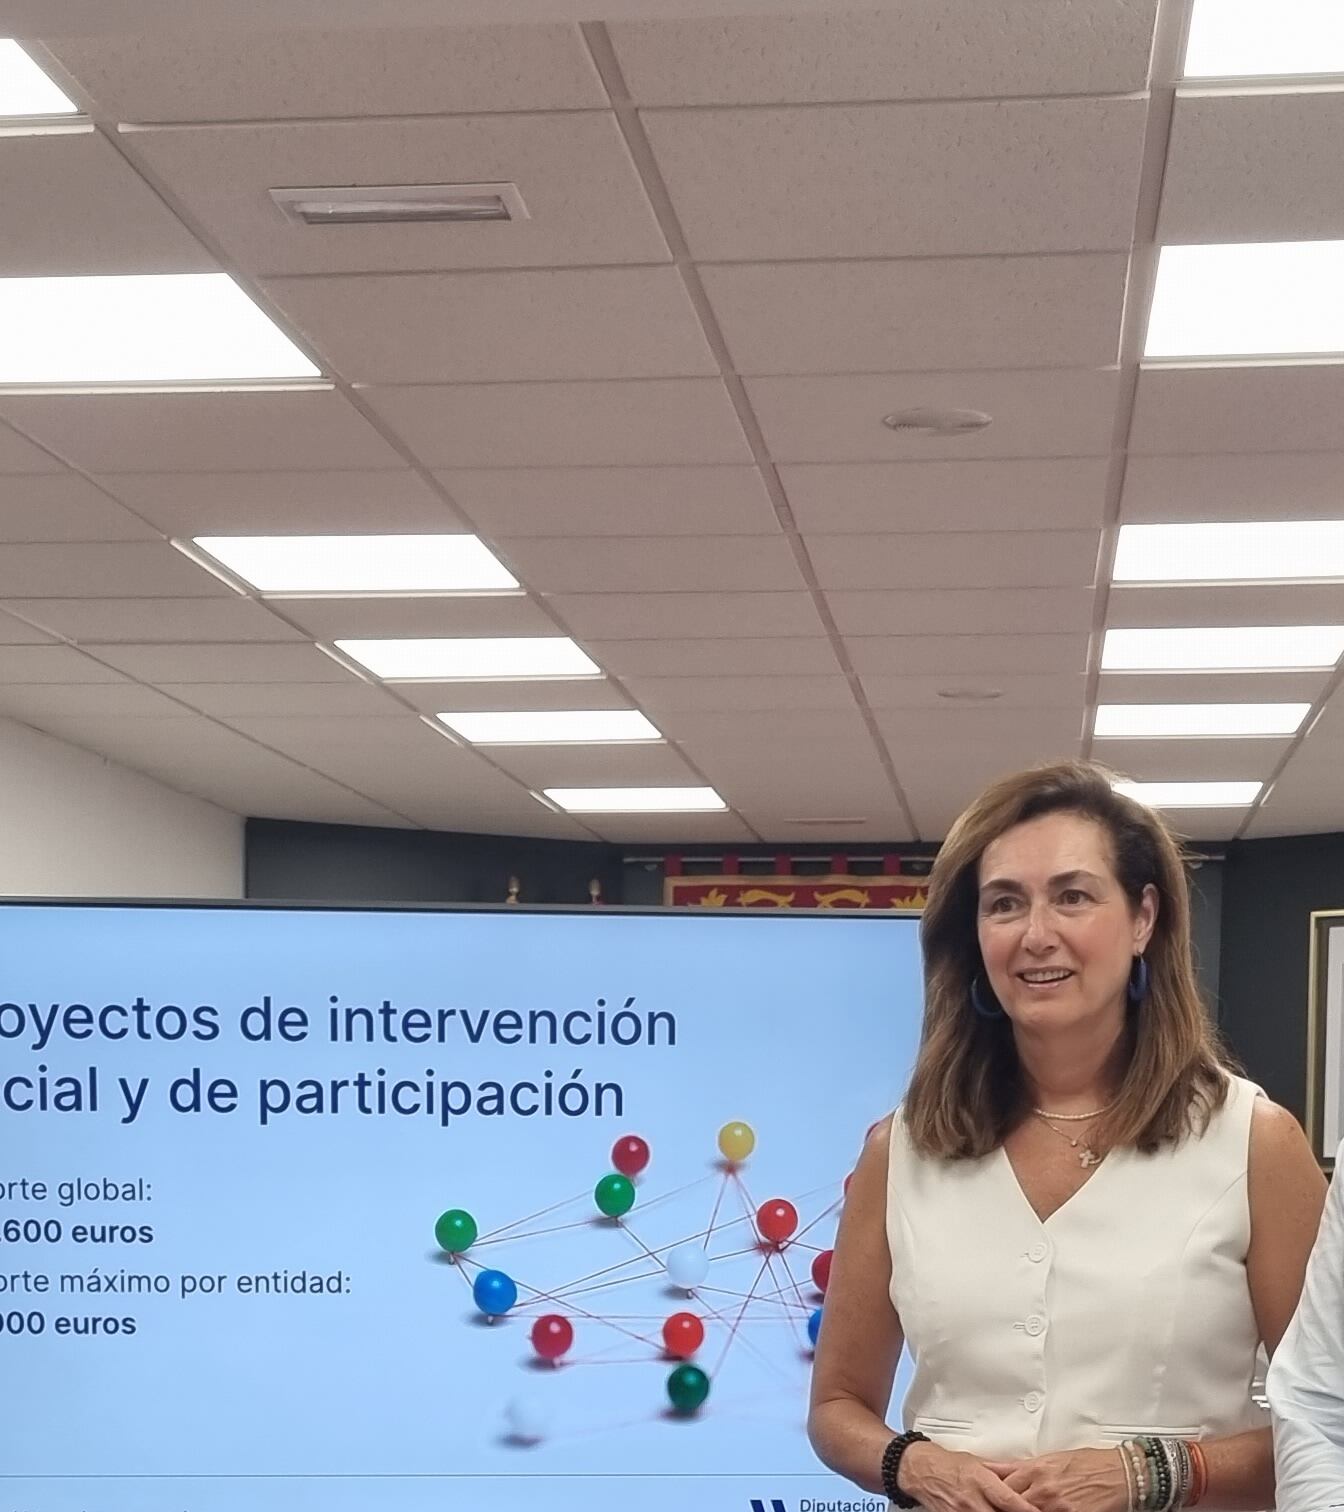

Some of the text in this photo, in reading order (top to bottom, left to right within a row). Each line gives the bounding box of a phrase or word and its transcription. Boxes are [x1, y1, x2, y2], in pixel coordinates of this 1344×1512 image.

[240, 995, 308, 1042] de
[330, 995, 676, 1046] intervención
[118, 1078, 150, 1124] y
[170, 1067, 238, 1113] de
[260, 1067, 623, 1126] participación
[58, 1177, 152, 1208] global:
[72, 1224, 154, 1244] euros
[60, 1268, 171, 1294] máximo
[181, 1275, 228, 1299] por
[237, 1269, 351, 1294] entidad:
[55, 1316, 137, 1336] euros
